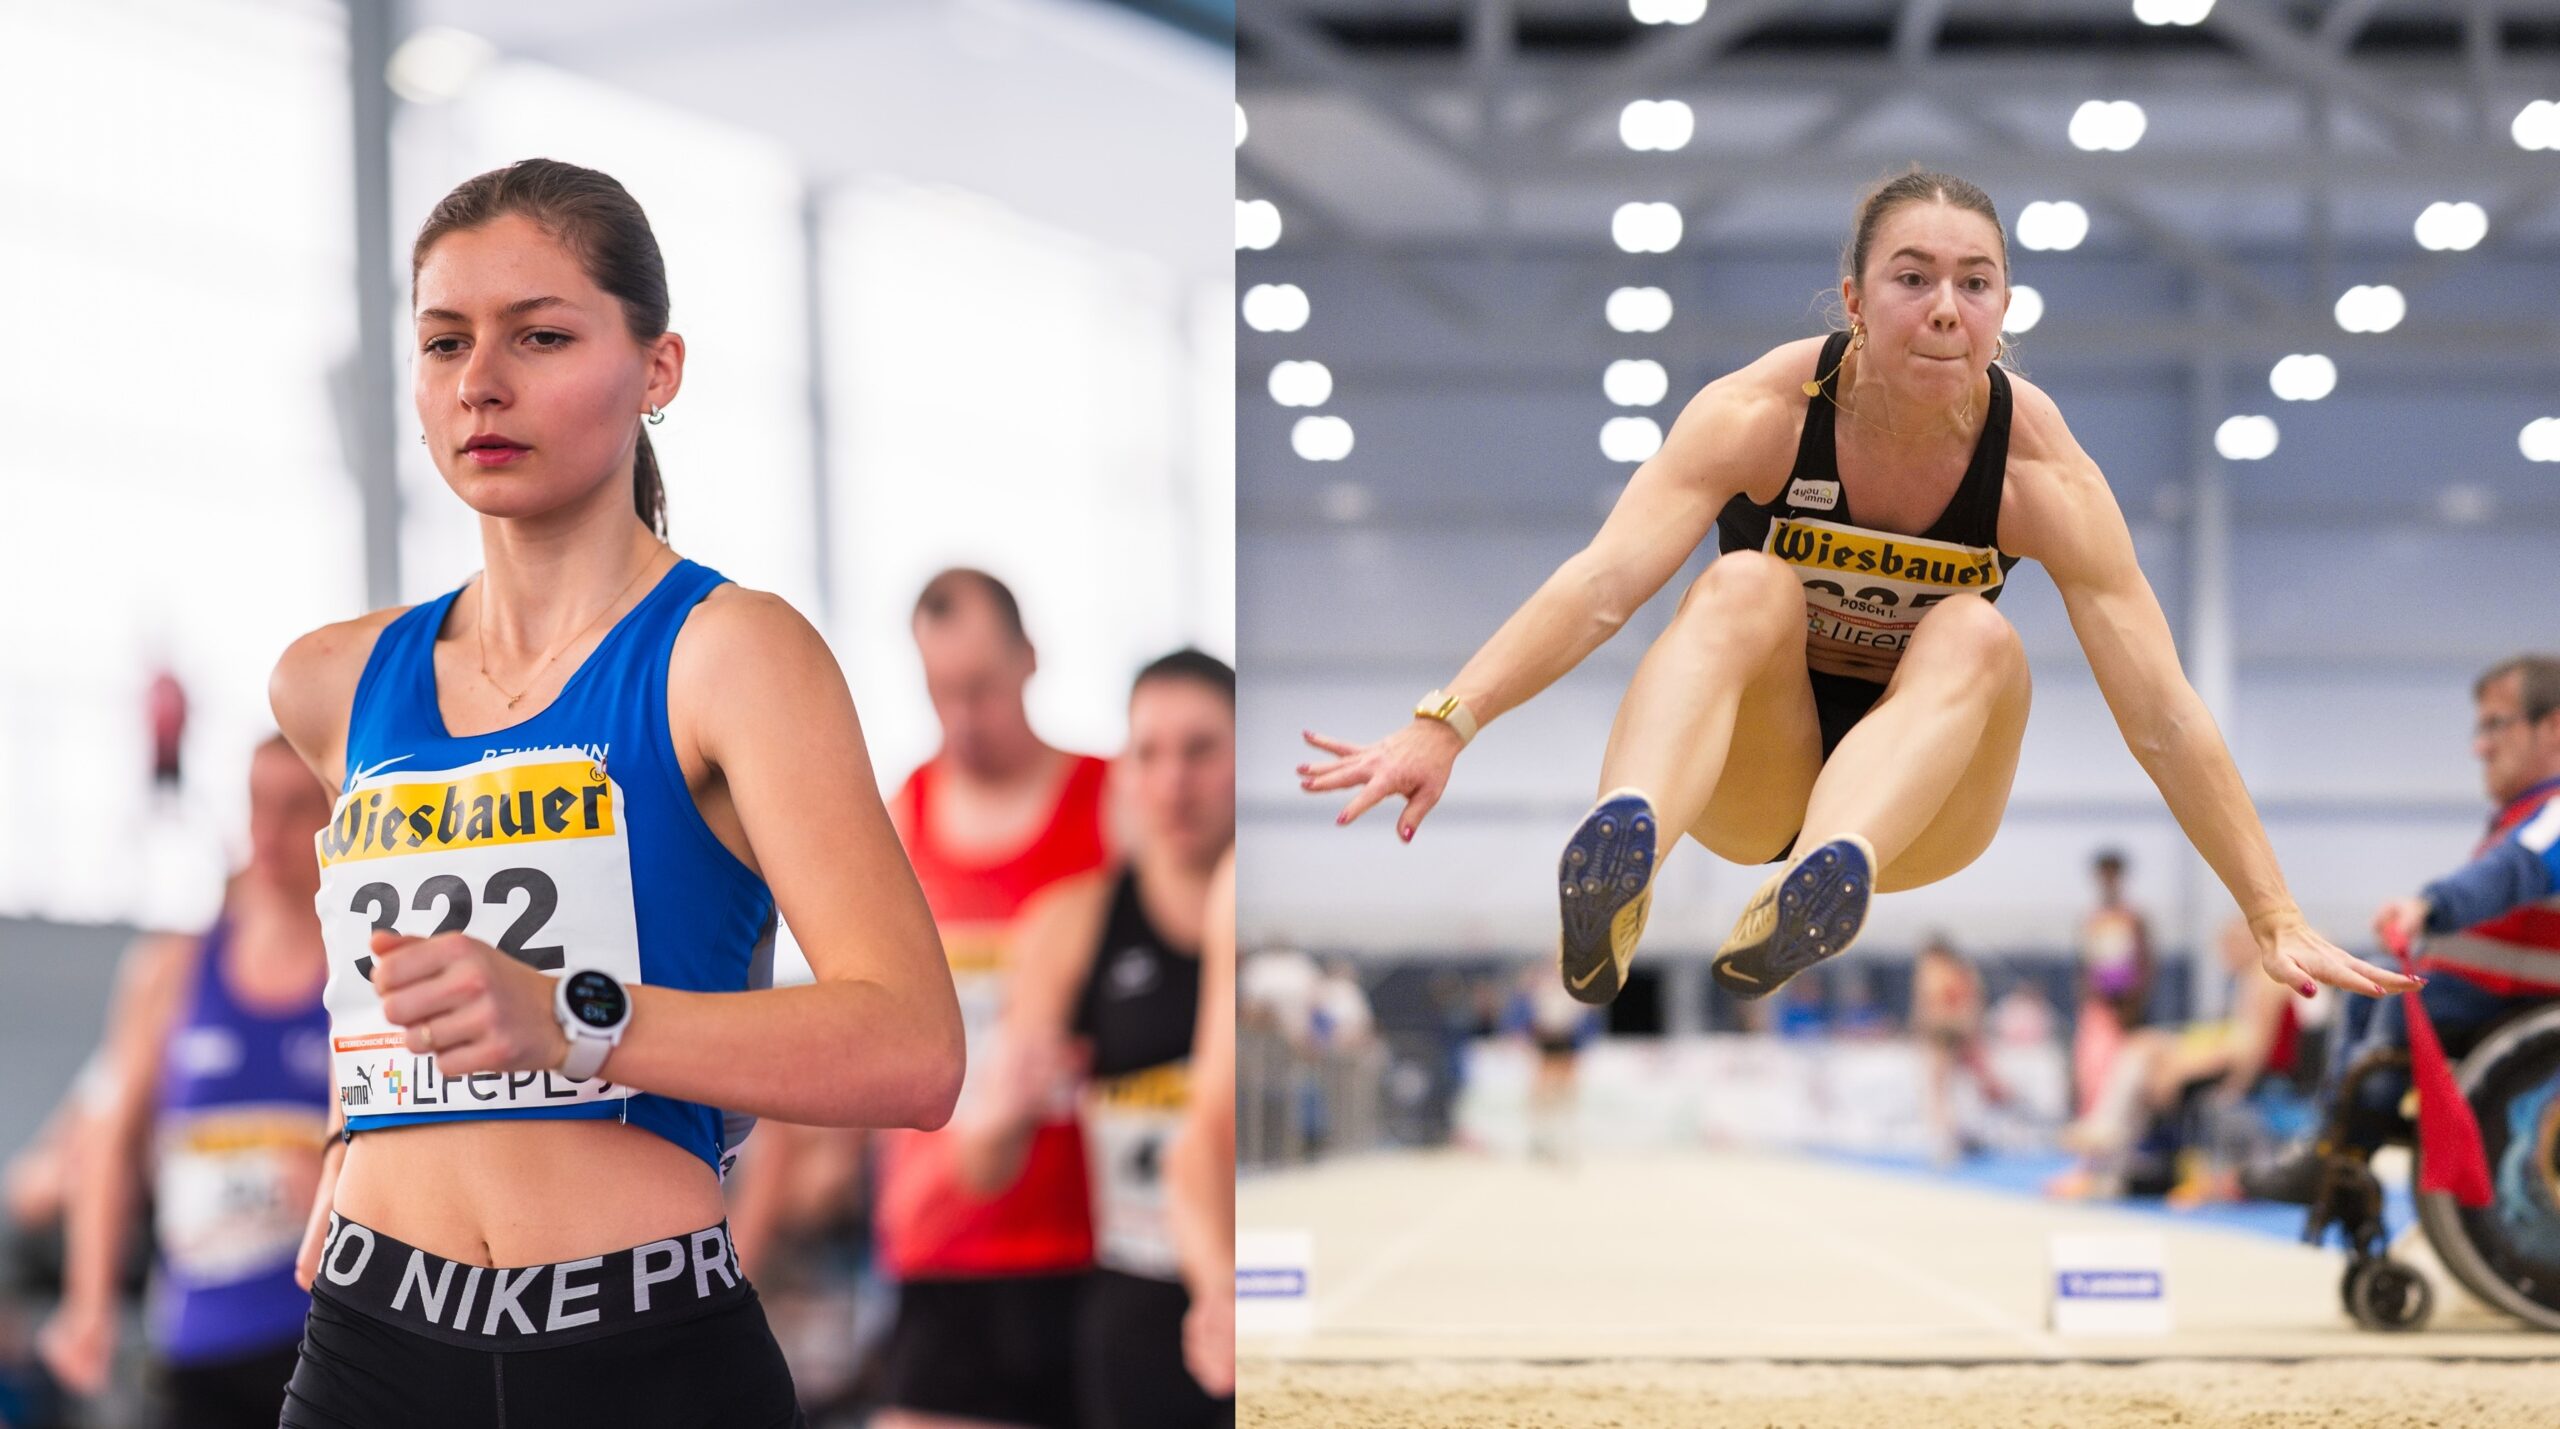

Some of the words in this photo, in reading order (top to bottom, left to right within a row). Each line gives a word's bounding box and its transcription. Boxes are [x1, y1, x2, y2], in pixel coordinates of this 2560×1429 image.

[1774, 522, 1993, 585] Wiesbauer
[1840, 598, 1885, 616] POSCH
[1889, 609, 1897, 619] I.
[322, 782, 608, 860] Wiesbauer
[341, 1085, 369, 1105] PUMA
[390, 1249, 604, 1335] NIKE
